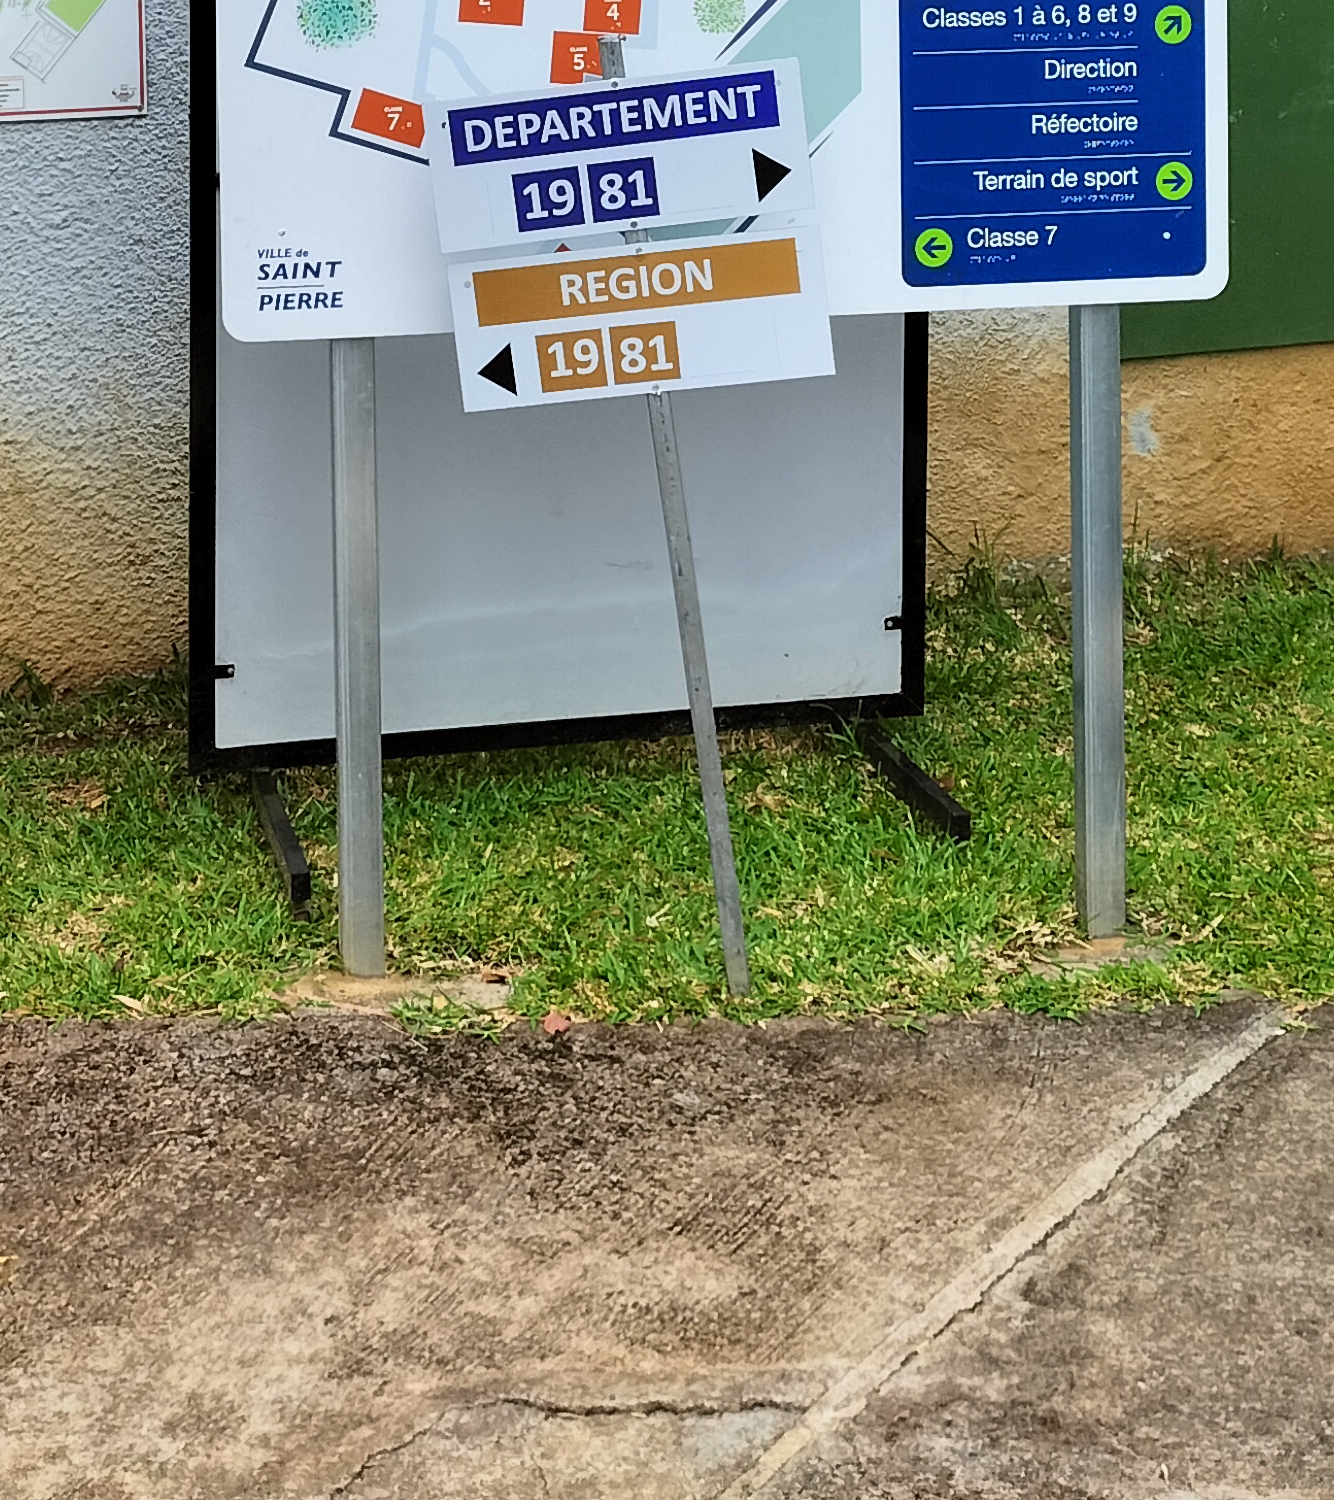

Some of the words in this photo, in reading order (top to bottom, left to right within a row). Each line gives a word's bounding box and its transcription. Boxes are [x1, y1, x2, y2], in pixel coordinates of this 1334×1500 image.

[606, 4, 620, 21] 4
[922, 7, 1007, 28] Classes
[1013, 5, 1023, 25] 1
[1032, 4, 1046, 25] à
[1051, 4, 1071, 27] 6,
[1077, 3, 1091, 23] 8
[1097, 4, 1118, 23] et
[1123, 2, 1138, 23] 9
[573, 54, 585, 71] 5
[1044, 58, 1138, 79] Direction
[387, 113, 400, 131] 7
[463, 84, 761, 153] DEPARTEMENT
[1031, 111, 1139, 134] Réfectoire
[973, 169, 1045, 191] Terrain
[1051, 167, 1079, 188] de
[1083, 166, 1139, 191] sport
[521, 179, 576, 220] 19
[598, 169, 654, 211] 81
[967, 227, 1040, 248] Classe
[1045, 225, 1058, 245] 7
[257, 248, 292, 259] VILLE
[295, 248, 309, 258] de
[257, 260, 342, 281] SAINT
[558, 258, 714, 307] REGION
[258, 291, 344, 312] PIERRE
[547, 337, 600, 377] 19
[619, 334, 674, 375] 81
